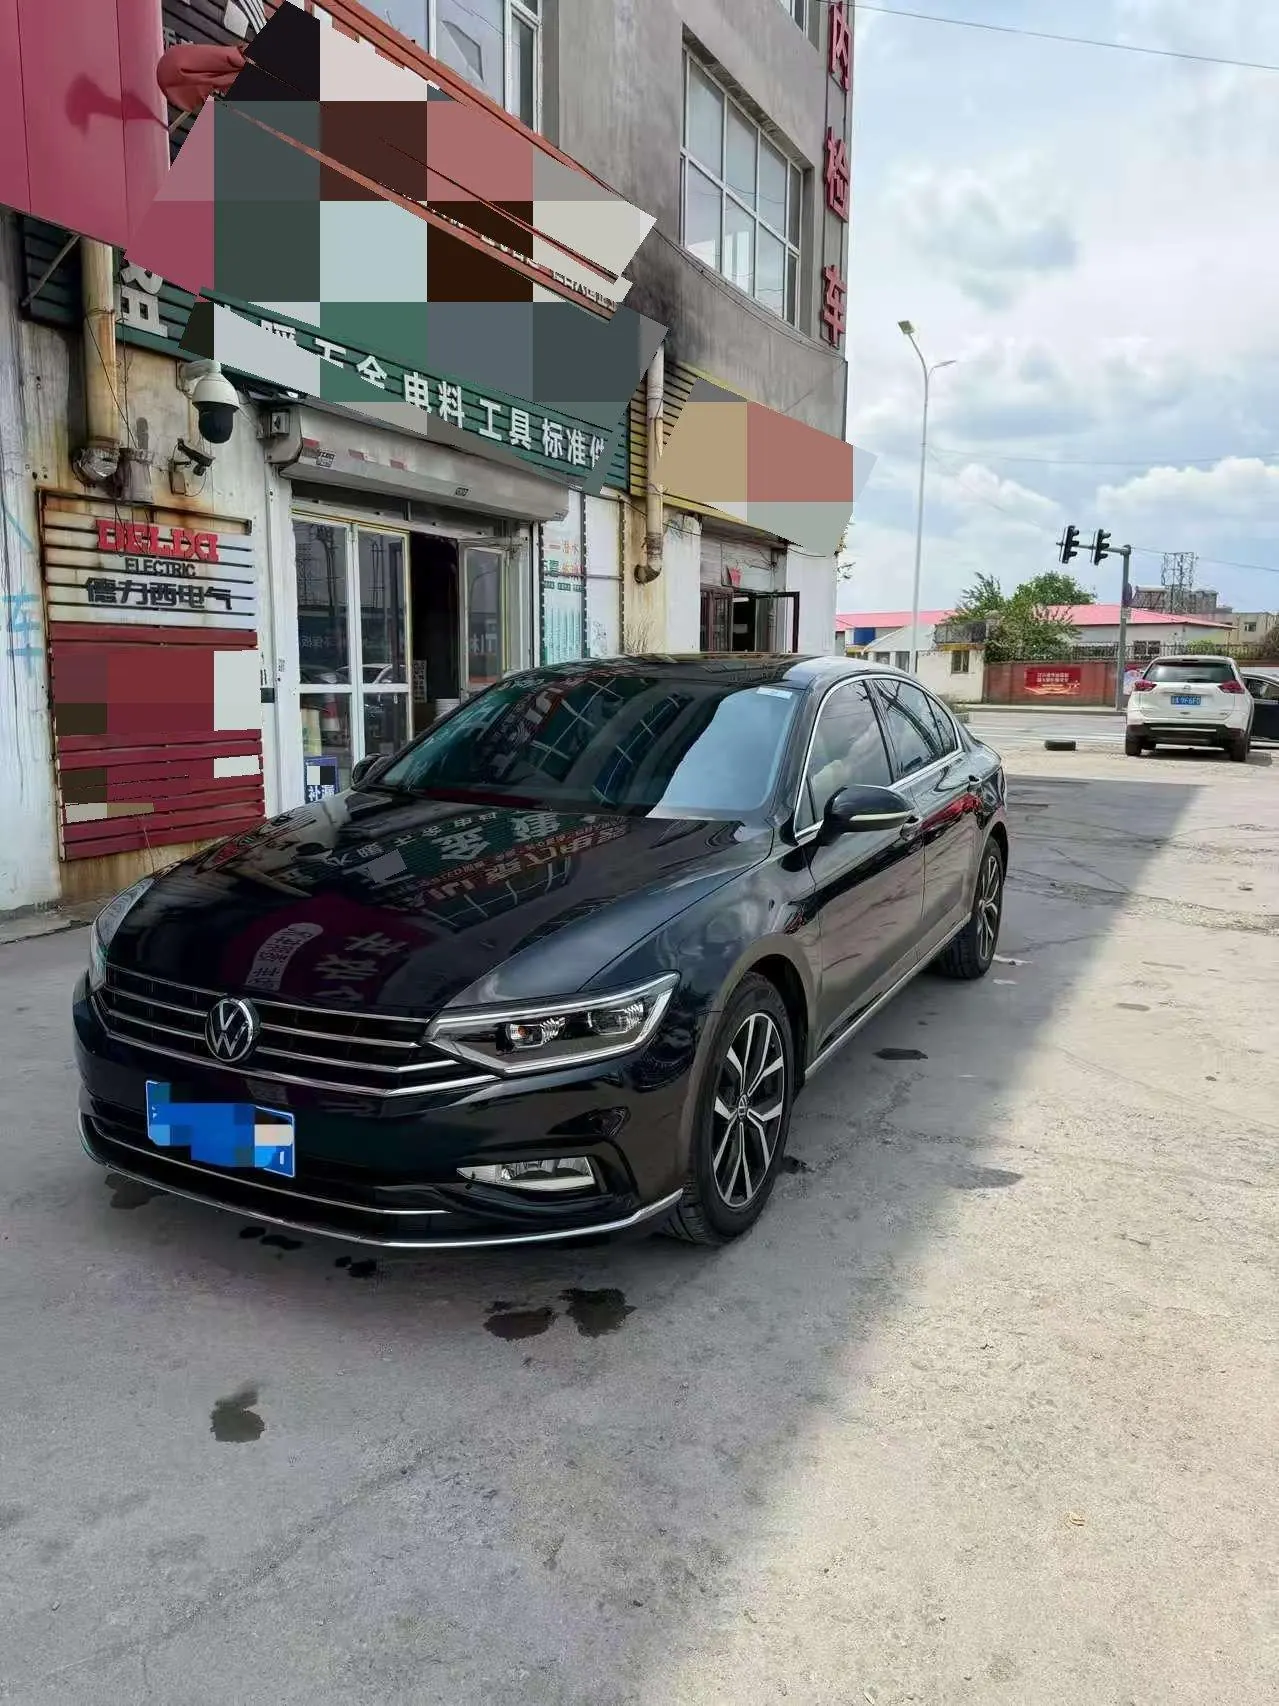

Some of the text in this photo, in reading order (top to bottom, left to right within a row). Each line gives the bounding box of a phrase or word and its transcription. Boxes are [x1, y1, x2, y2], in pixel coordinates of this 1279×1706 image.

[125, 556, 197, 577] ELECTRIC
[87, 576, 232, 610] 德力西电气
